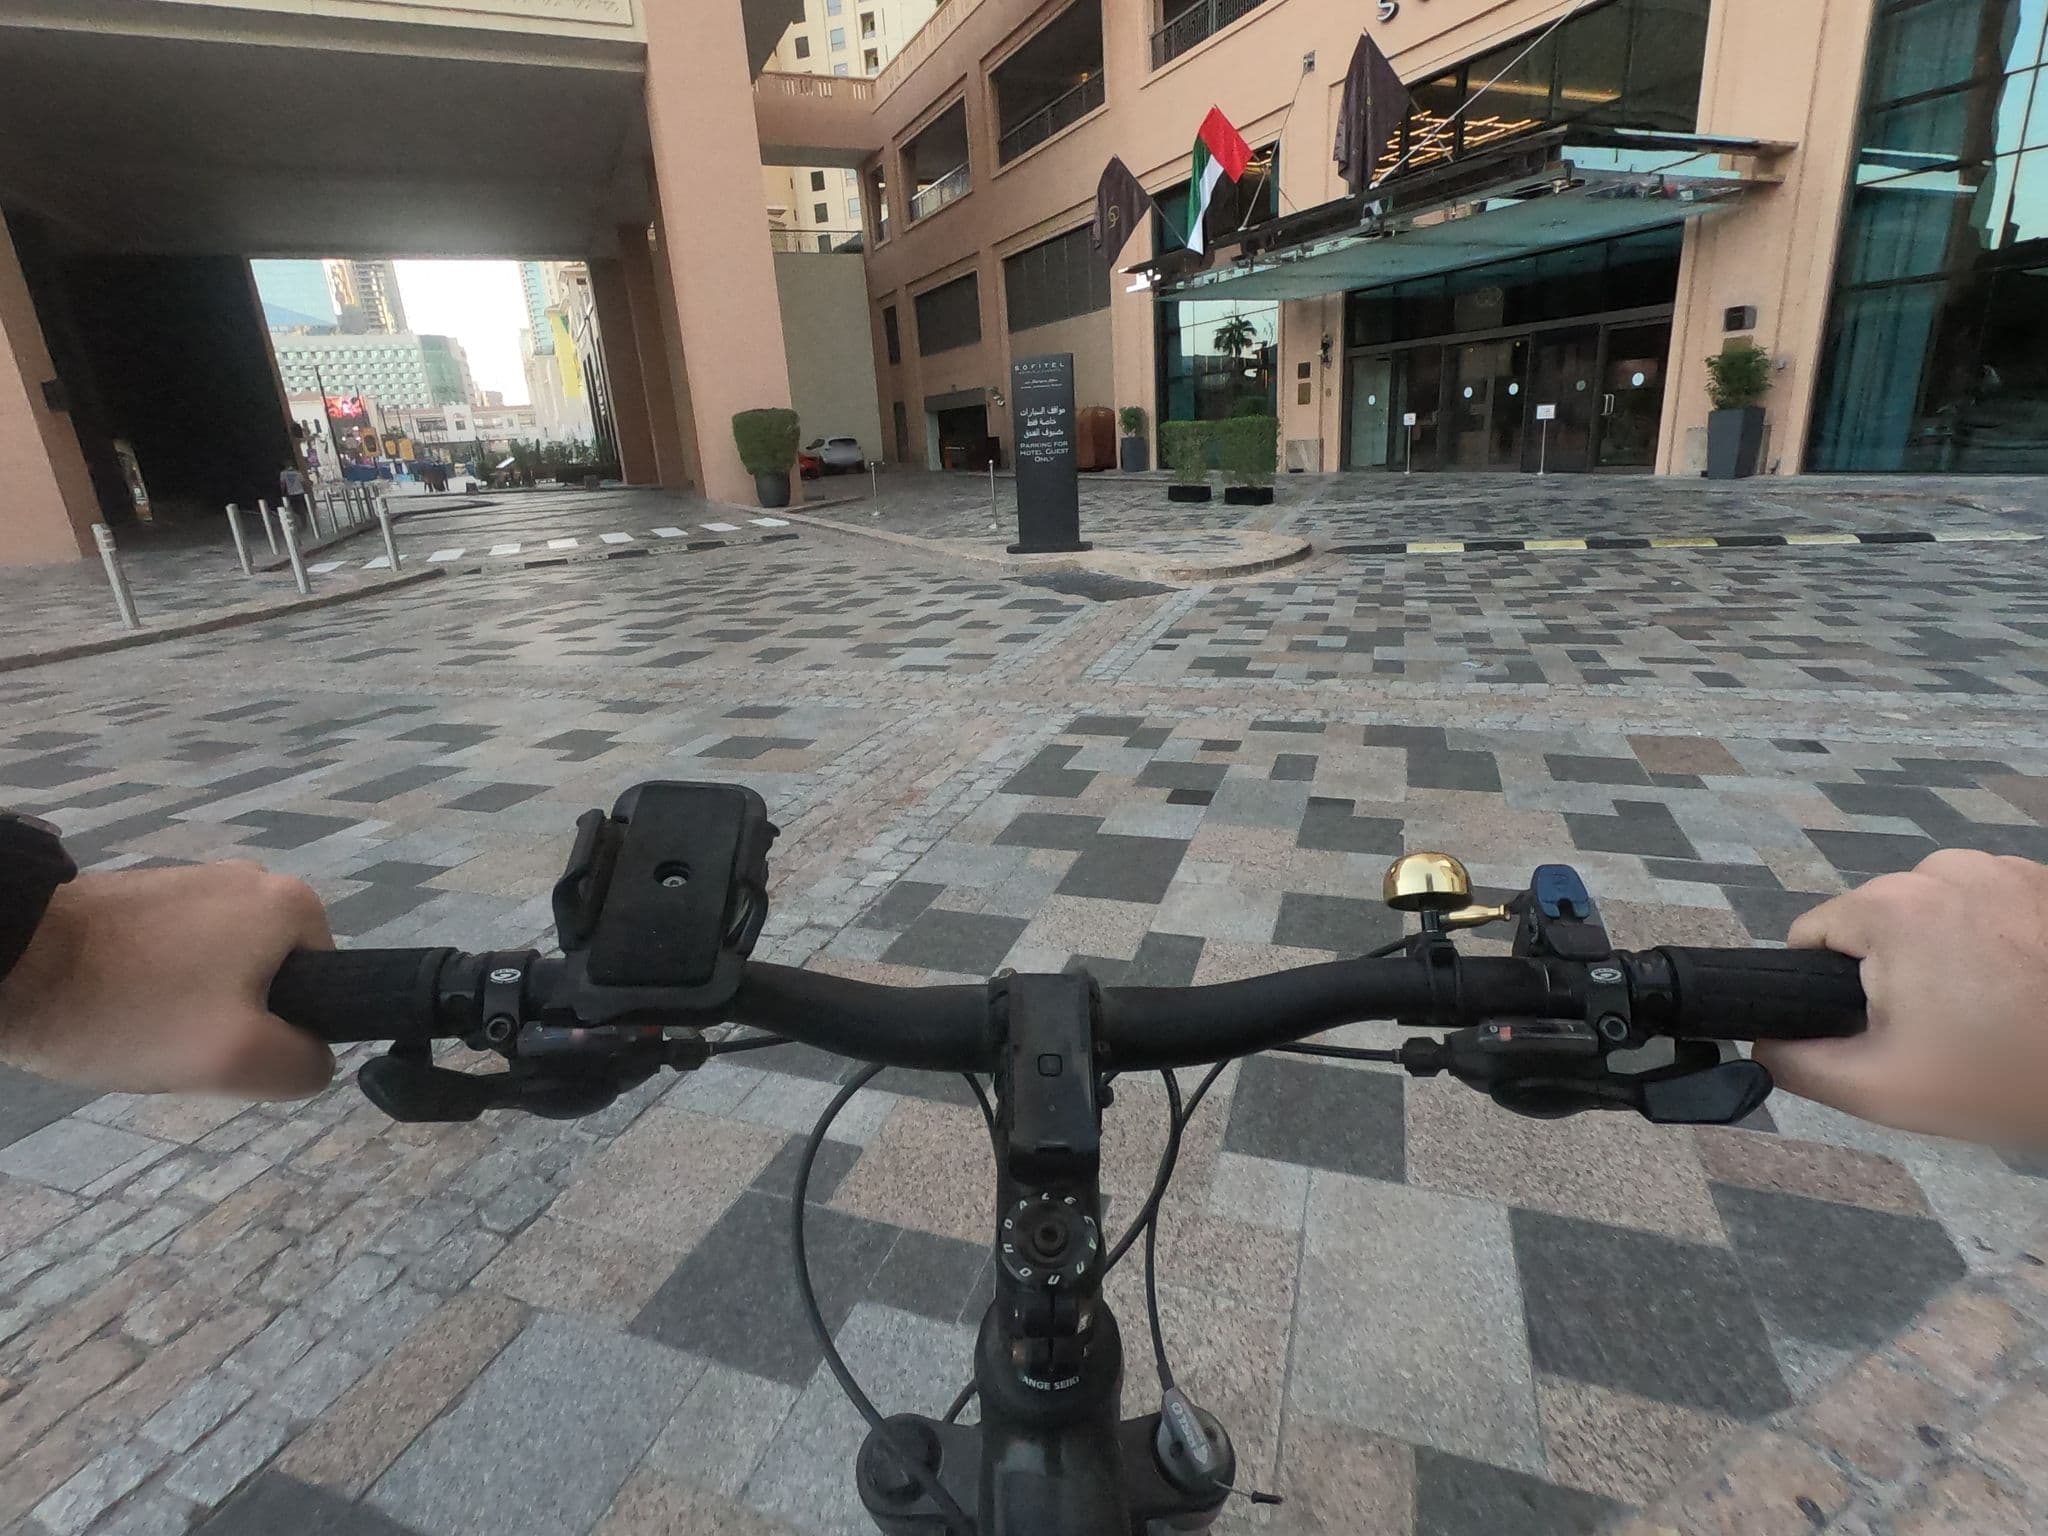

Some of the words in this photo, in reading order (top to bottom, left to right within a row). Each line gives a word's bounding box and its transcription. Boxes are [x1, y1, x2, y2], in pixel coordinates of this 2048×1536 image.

[1014, 362, 1065, 371] SOFITEL
[1034, 455, 1055, 463] ONLY
[1020, 1374, 1051, 1391] ANGE
